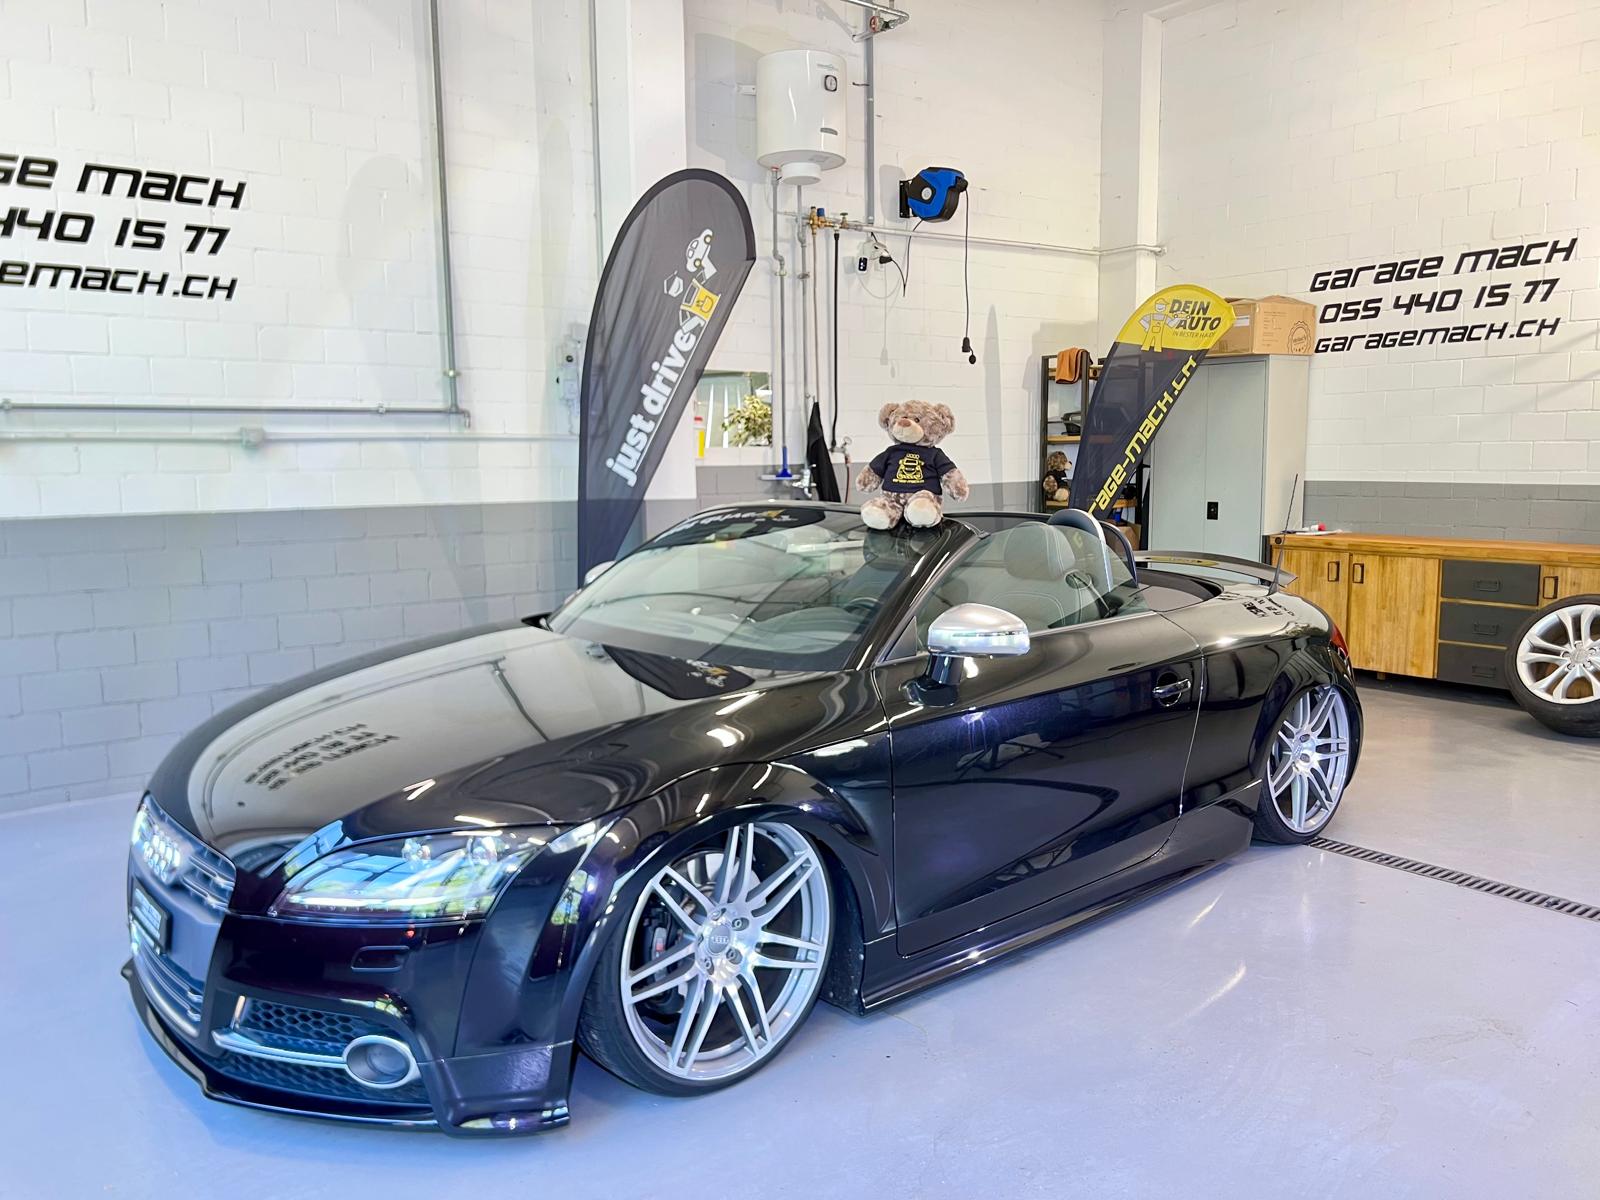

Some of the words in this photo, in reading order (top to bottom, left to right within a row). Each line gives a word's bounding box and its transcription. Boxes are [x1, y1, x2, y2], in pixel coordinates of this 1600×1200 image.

[115, 217, 167, 251] 15
[184, 223, 231, 256] 77
[1168, 298, 1211, 316] DEIN
[1319, 297, 1383, 324] 055
[1393, 288, 1463, 316] 440
[1473, 283, 1512, 309] 15
[1522, 278, 1560, 304] 77
[1175, 316, 1221, 331] AUTO
[605, 413, 656, 487] just
[641, 327, 696, 416] drive
